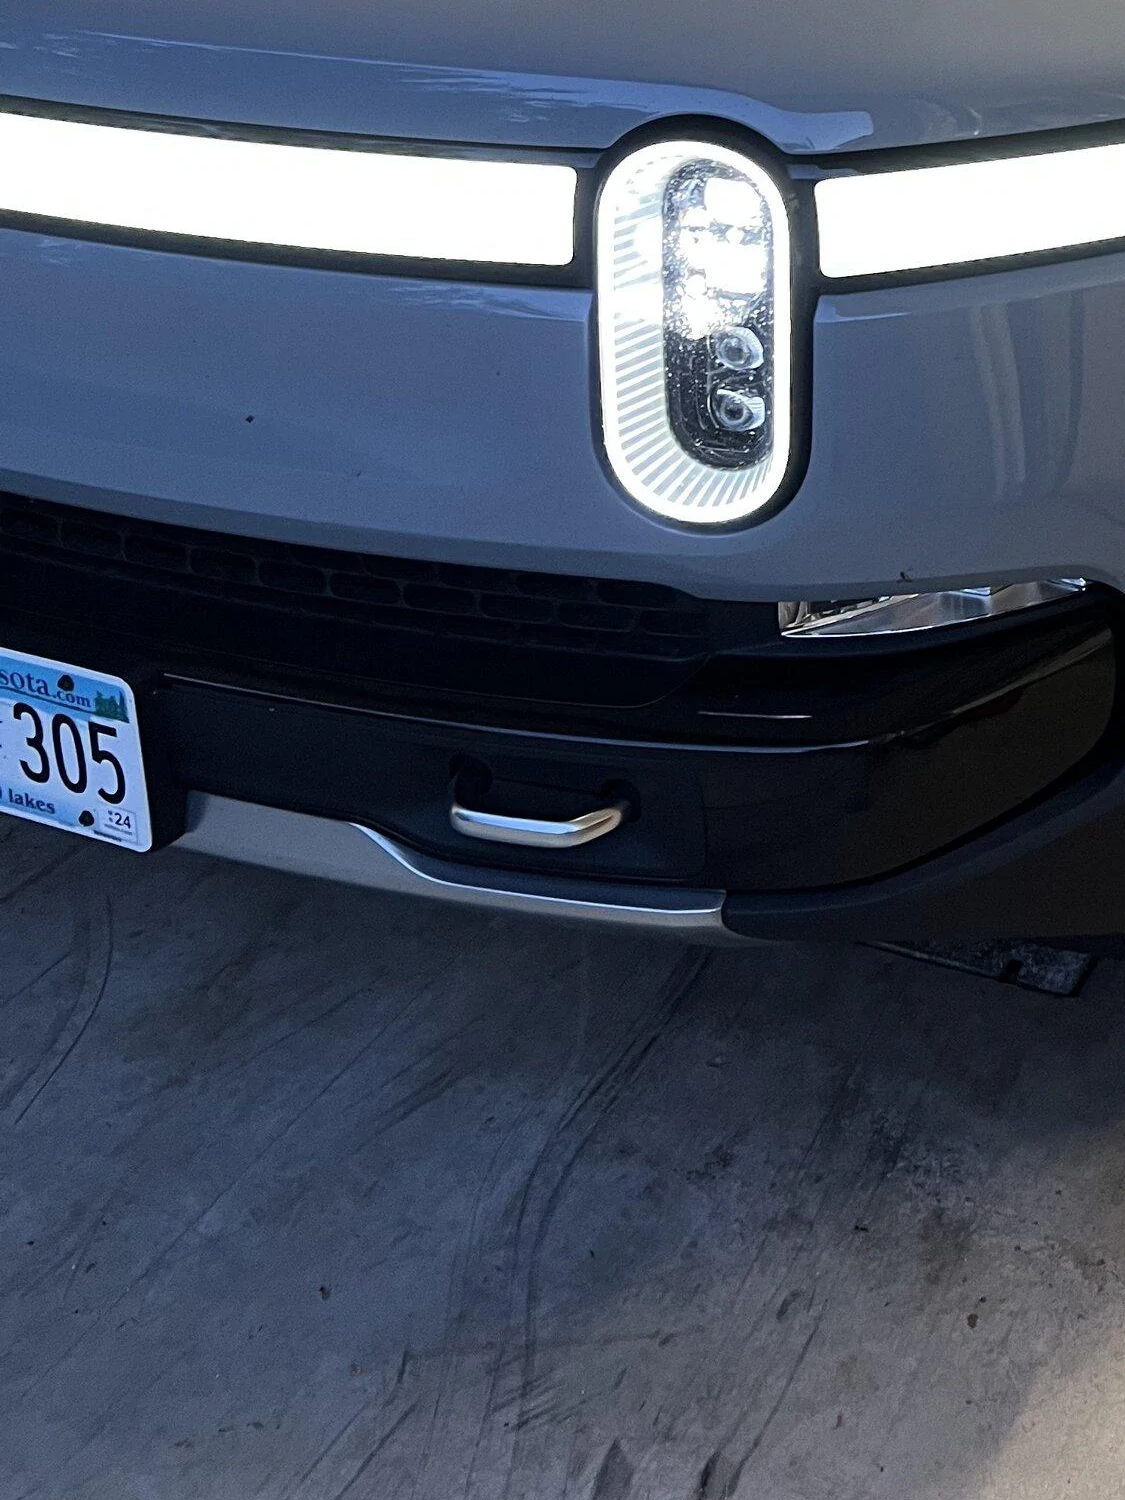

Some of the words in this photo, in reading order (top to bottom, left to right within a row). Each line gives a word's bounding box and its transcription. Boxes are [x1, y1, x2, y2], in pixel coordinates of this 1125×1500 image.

[13, 702, 126, 804] 305
[9, 788, 56, 814] lakes
[115, 812, 131, 829] 24
